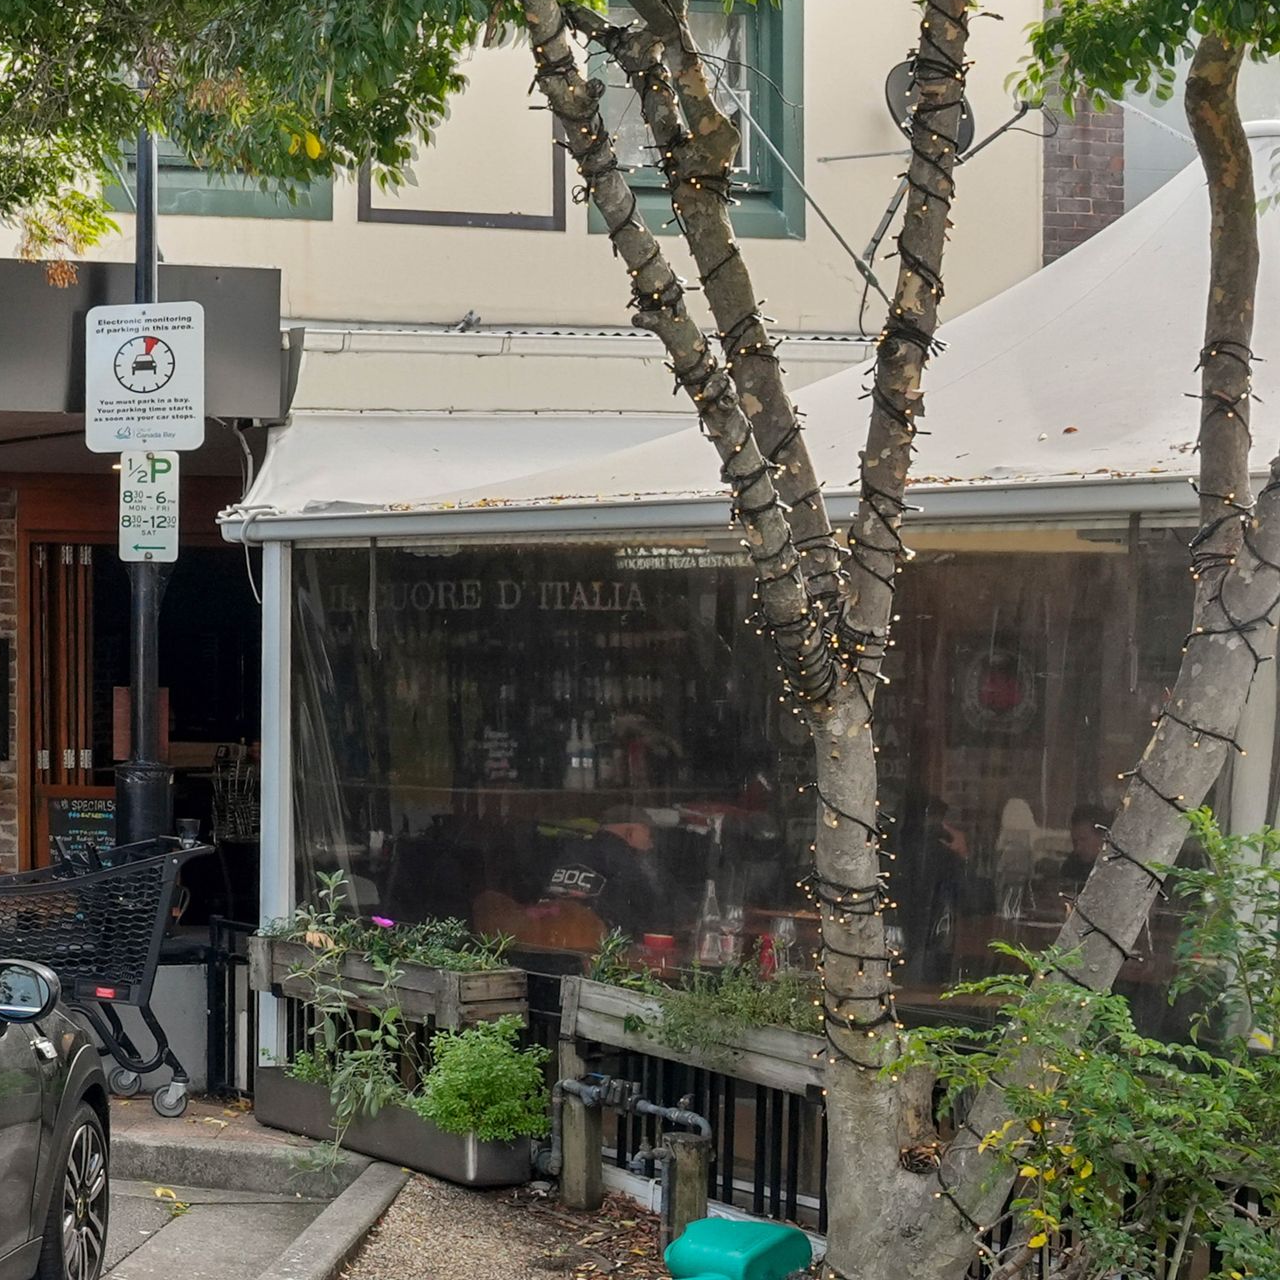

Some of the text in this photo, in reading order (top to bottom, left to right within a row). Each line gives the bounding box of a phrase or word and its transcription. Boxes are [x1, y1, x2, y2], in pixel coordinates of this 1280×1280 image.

[97, 315, 192, 326] Electronic monitoring
[106, 326, 140, 335] parking
[174, 397, 190, 405] bay.
[116, 406, 147, 415] parking
[169, 404, 193, 412] starts
